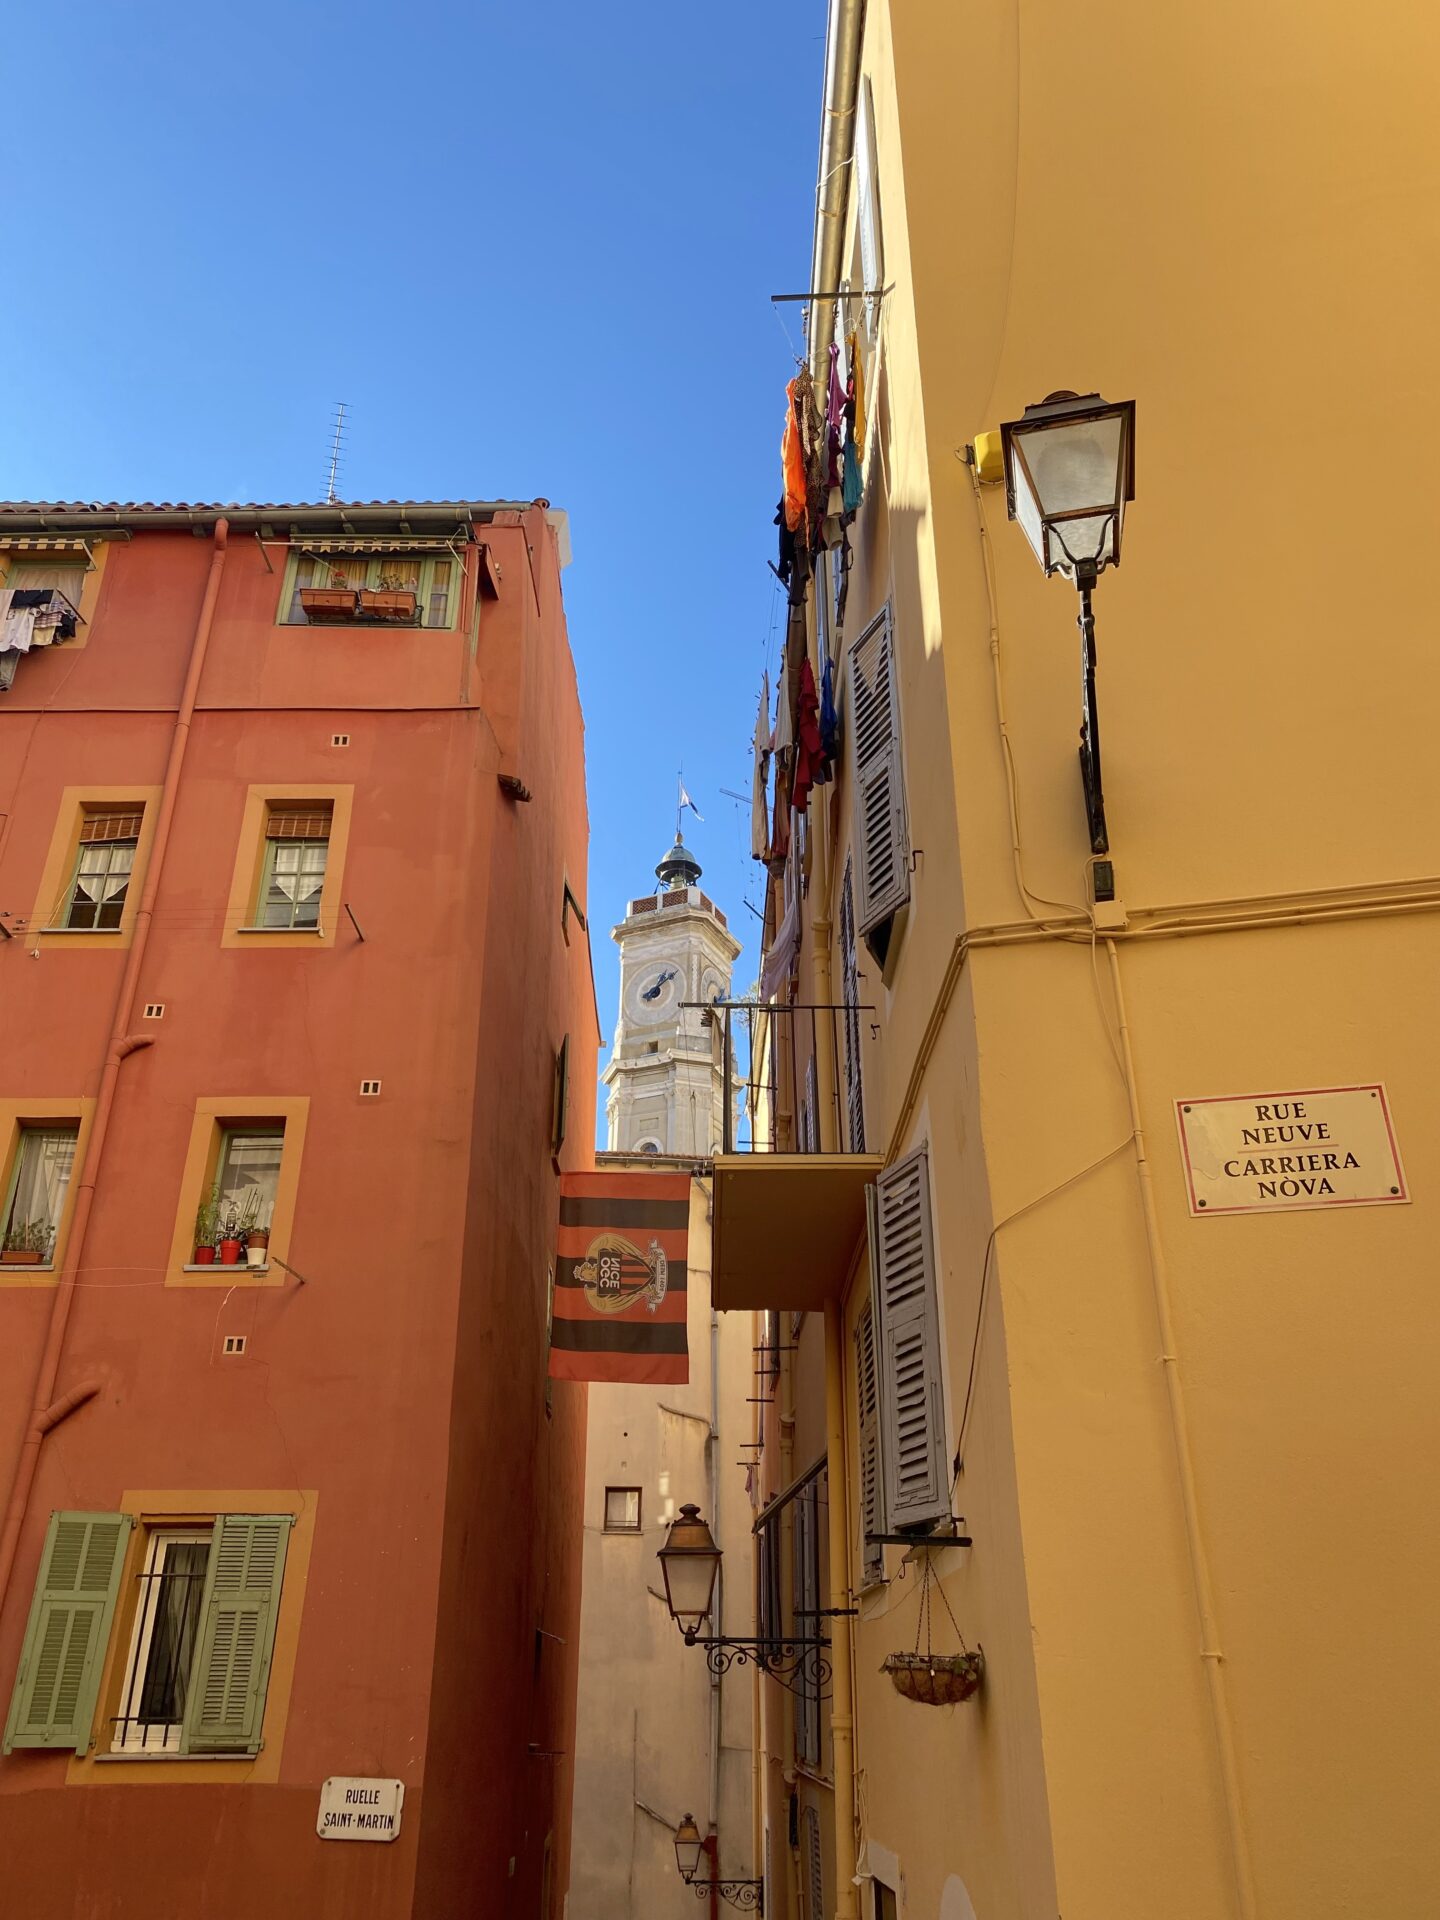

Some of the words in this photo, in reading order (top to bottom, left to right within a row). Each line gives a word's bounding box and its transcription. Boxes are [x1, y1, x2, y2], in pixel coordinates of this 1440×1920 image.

[1255, 1102, 1307, 1121] RUE
[1241, 1123, 1331, 1145] NEUVE
[1224, 1152, 1361, 1177] CARRIERA
[1257, 1177, 1336, 1199] NÒVA
[345, 1789, 380, 1804] RUELLE
[323, 1812, 395, 1829] SAINT-MARTIN
